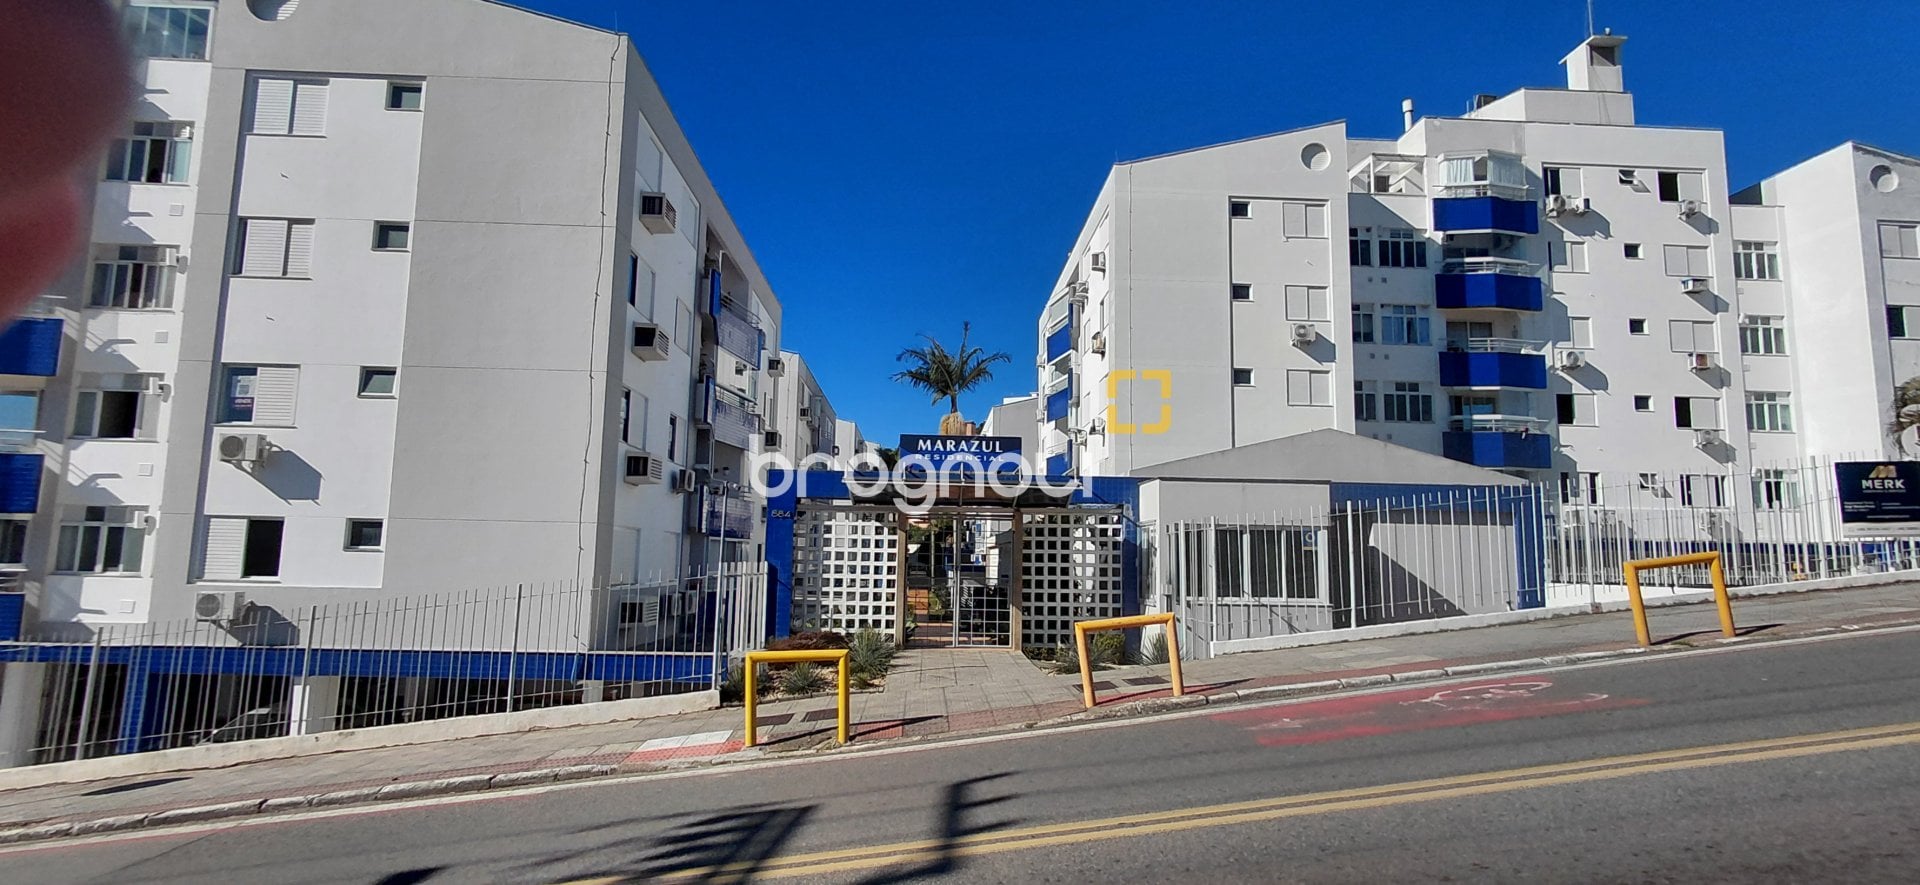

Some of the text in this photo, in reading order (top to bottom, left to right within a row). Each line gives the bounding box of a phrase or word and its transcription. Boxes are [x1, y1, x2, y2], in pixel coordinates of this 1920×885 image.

[917, 439, 1003, 453] MARAZUL
[915, 453, 1004, 462] RESIDENCIAL
[1861, 479, 1906, 489] MERK
